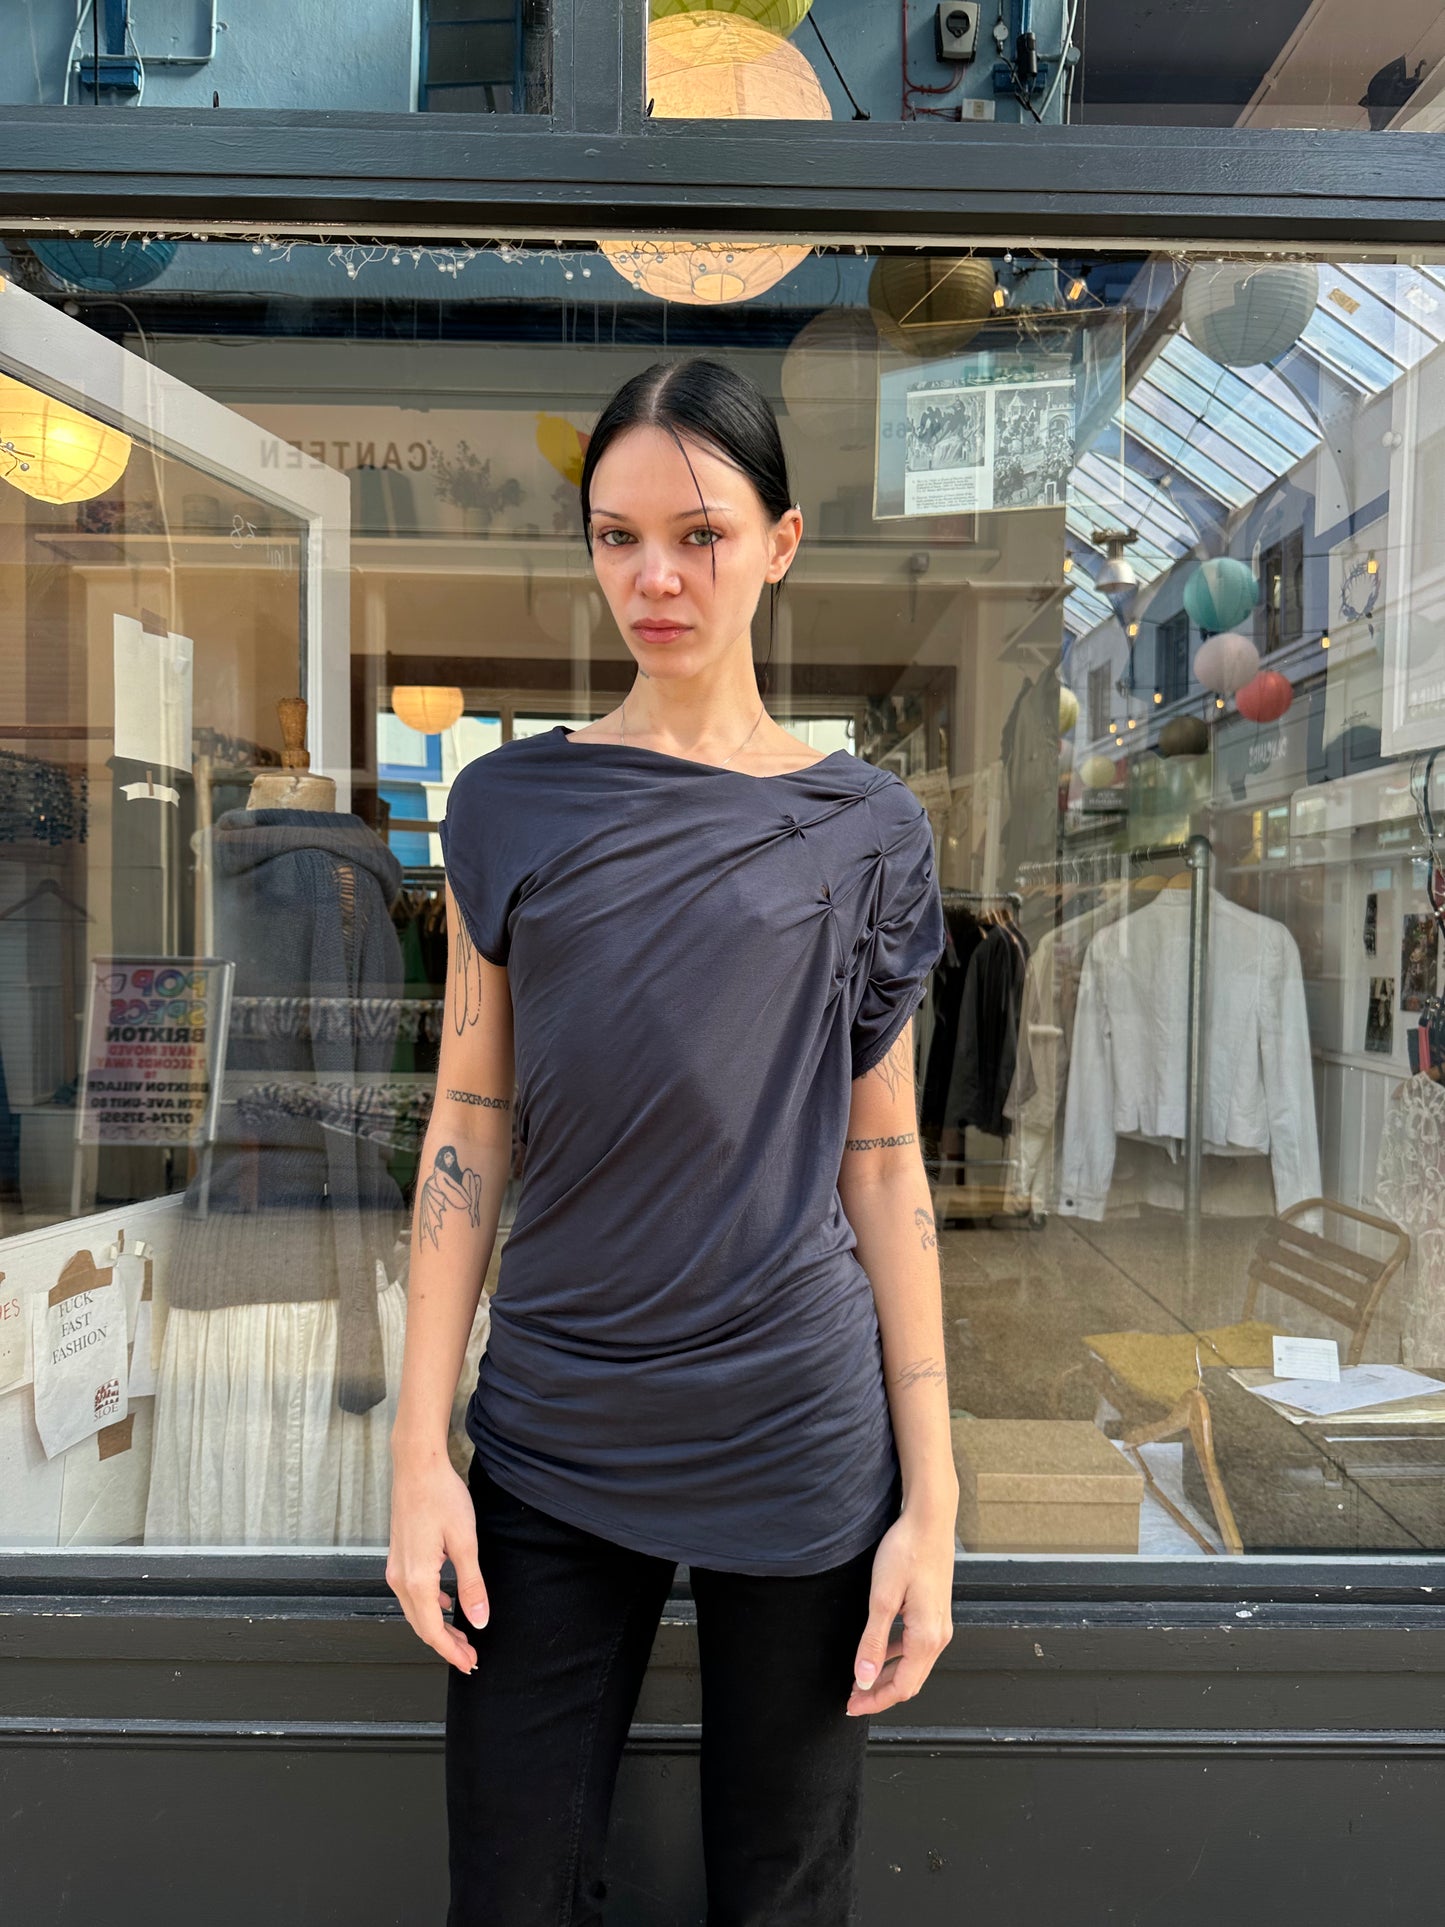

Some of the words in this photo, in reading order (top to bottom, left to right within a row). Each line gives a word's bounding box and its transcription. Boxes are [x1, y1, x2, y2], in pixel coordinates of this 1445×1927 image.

[0, 1298, 21, 1320] ES
[58, 1291, 94, 1318] FUCK
[61, 1312, 92, 1337] FAST
[52, 1325, 109, 1365] FASHION
